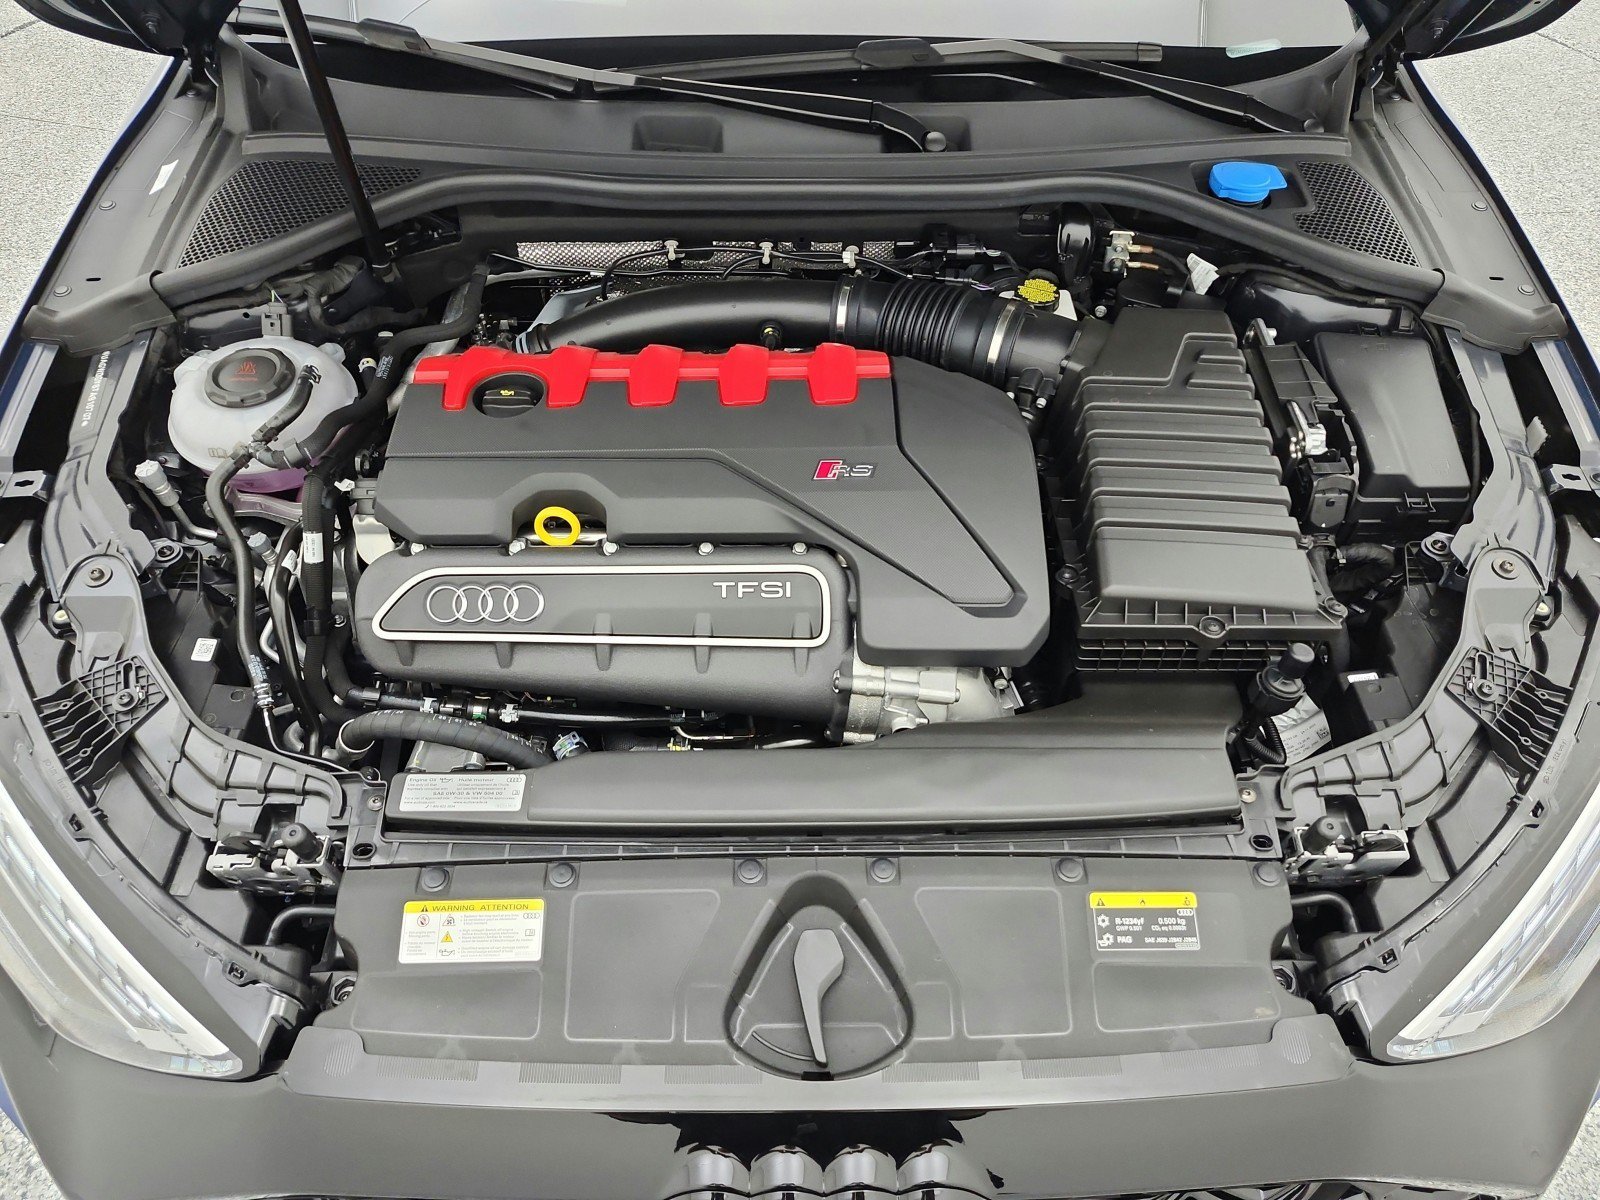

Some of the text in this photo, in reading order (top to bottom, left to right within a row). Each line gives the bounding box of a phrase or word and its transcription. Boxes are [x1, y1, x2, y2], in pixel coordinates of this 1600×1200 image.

[822, 461, 874, 479] RS
[713, 581, 791, 598] TFSI
[432, 903, 529, 912] WARNING ATTENTION
[1115, 917, 1144, 925] R-1234yf
[1177, 917, 1186, 925] kg
[1117, 935, 1133, 943] PAG
